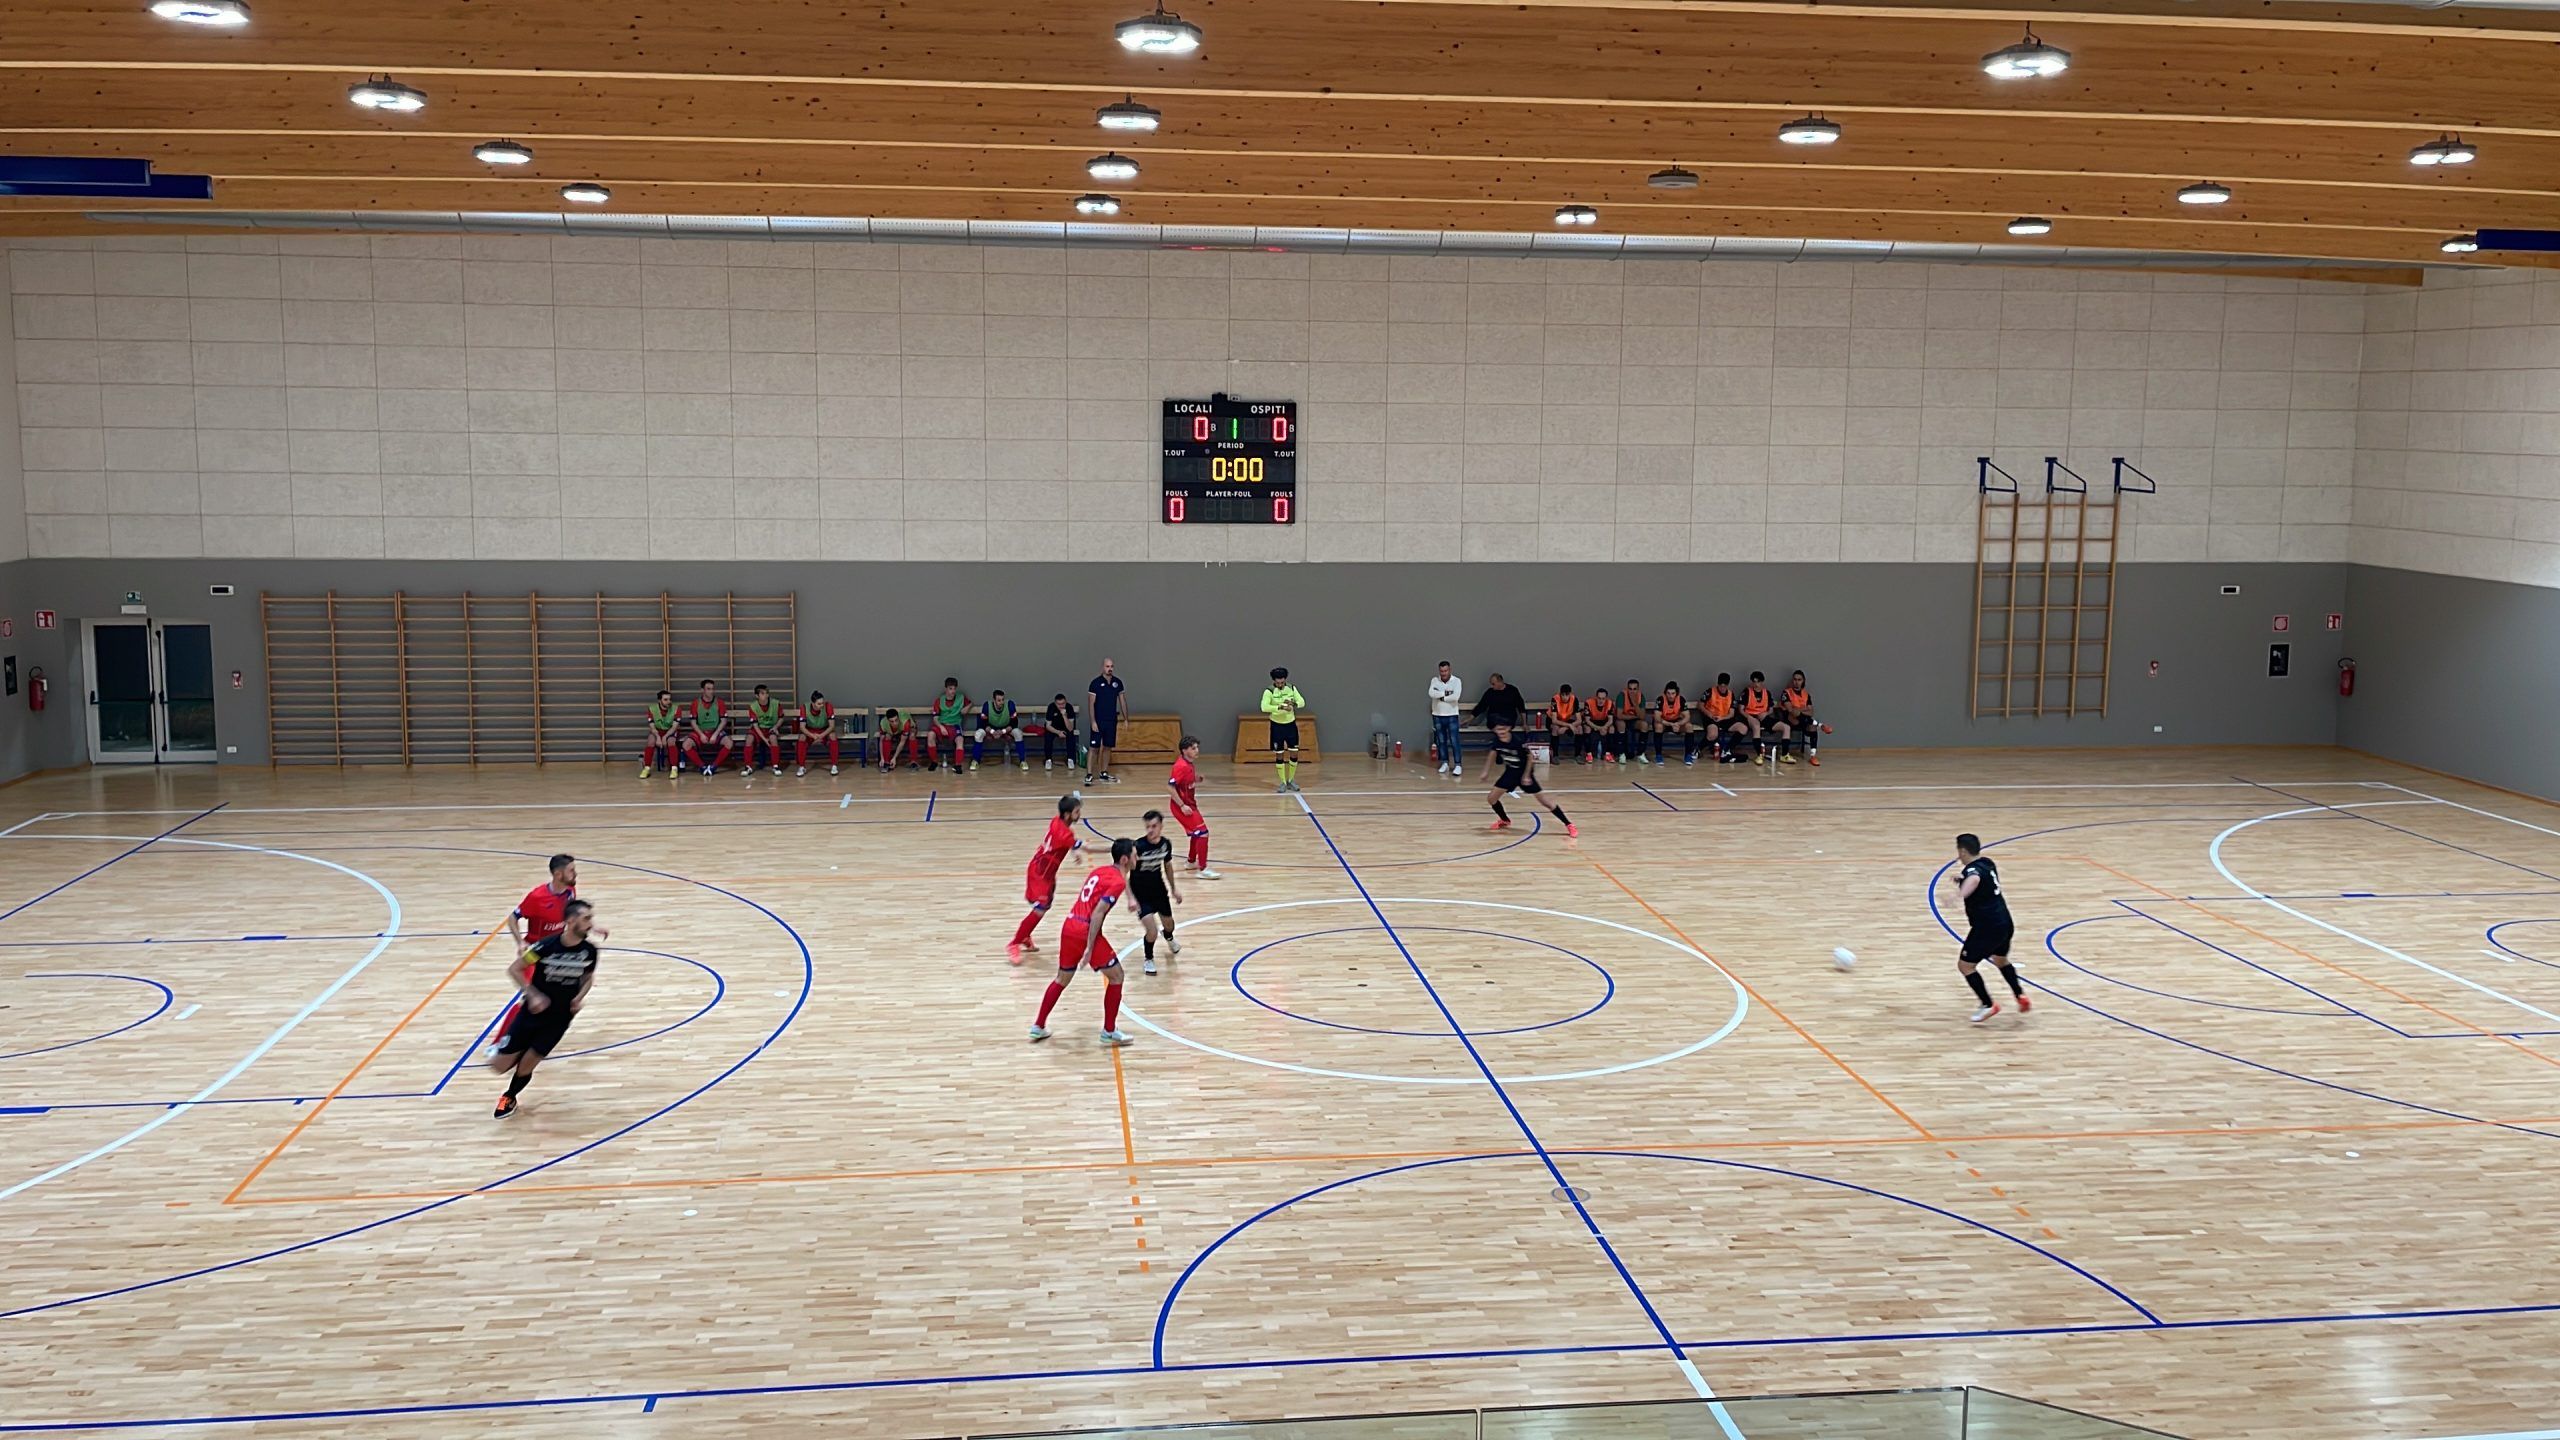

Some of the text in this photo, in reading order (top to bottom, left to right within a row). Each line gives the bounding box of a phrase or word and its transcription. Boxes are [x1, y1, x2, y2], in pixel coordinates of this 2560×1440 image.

[1174, 404, 1213, 413] LOCALI
[1250, 405, 1286, 414] OSPITI
[1195, 416, 1209, 440] 0
[1273, 417, 1287, 441] 0
[1212, 457, 1264, 482] 0:00
[1170, 498, 1185, 521] 0
[1274, 498, 1288, 522] 0
[1081, 875, 1099, 902] 8
